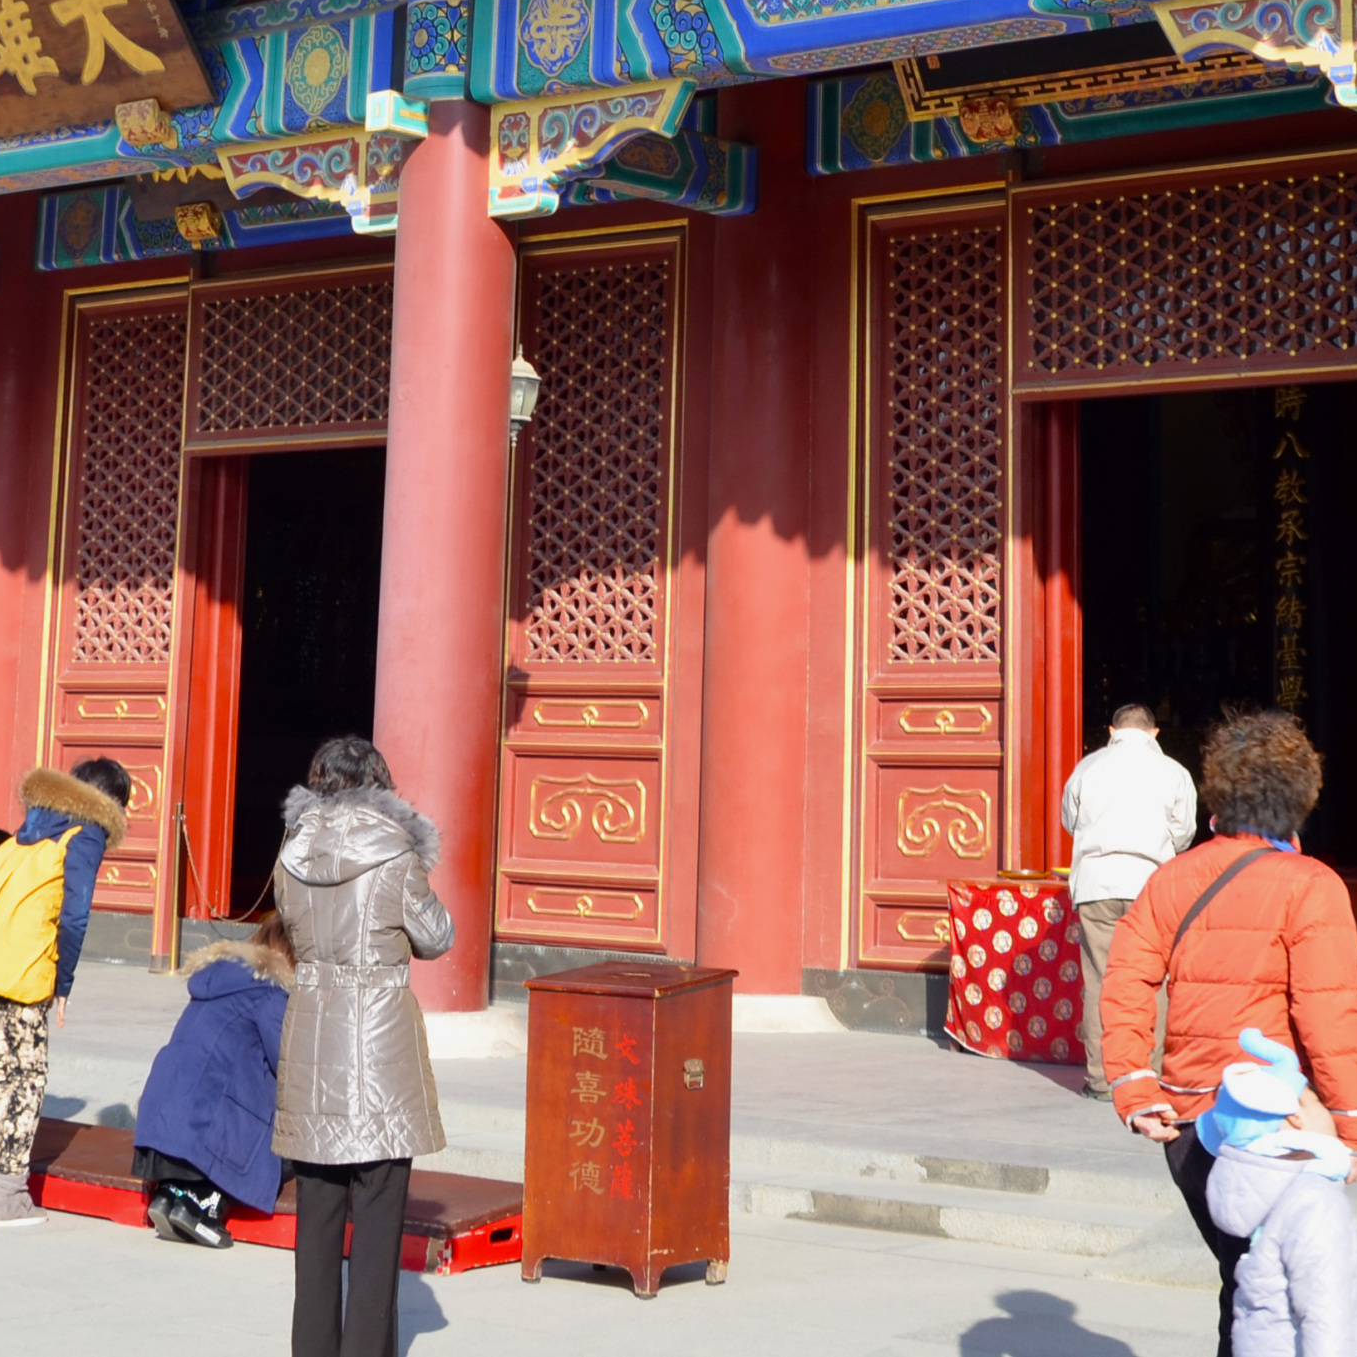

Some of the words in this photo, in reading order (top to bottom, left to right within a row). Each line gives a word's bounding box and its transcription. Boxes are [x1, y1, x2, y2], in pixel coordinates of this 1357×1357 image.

[569, 1026, 608, 1195] 隨喜功德
[611, 1033, 642, 1200] 文殊菩薩
